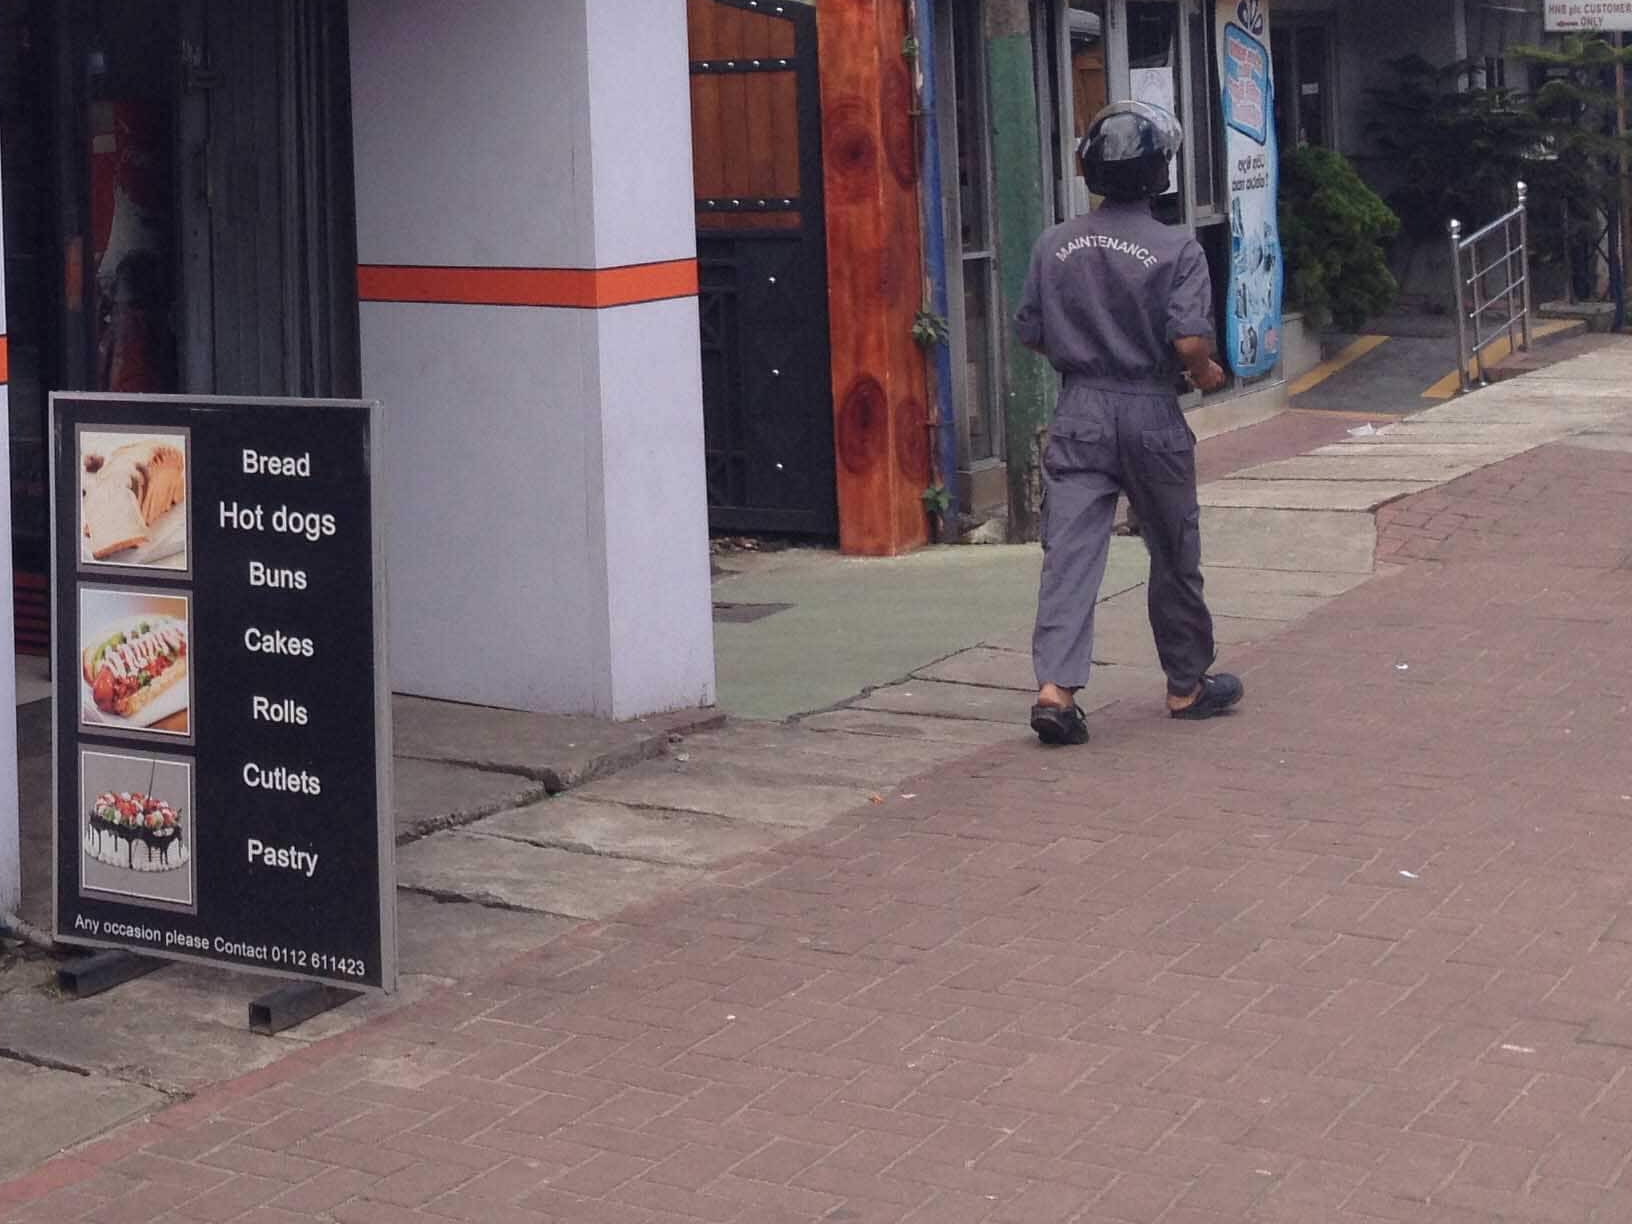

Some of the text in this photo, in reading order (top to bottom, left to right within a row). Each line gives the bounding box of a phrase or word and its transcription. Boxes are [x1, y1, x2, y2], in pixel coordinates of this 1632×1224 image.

[1580, 16, 1604, 27] ONLY
[1055, 235, 1158, 269] MAINTENANCE
[242, 447, 311, 478] Bread
[219, 500, 337, 543] Hot dogs
[249, 561, 308, 591] Buns
[244, 627, 315, 658] Cakes
[252, 695, 309, 725] Rolls
[243, 761, 322, 796] Cutlets
[247, 837, 319, 877] Pastry
[74, 914, 366, 978] Any occasion please Contact 0112 611423
